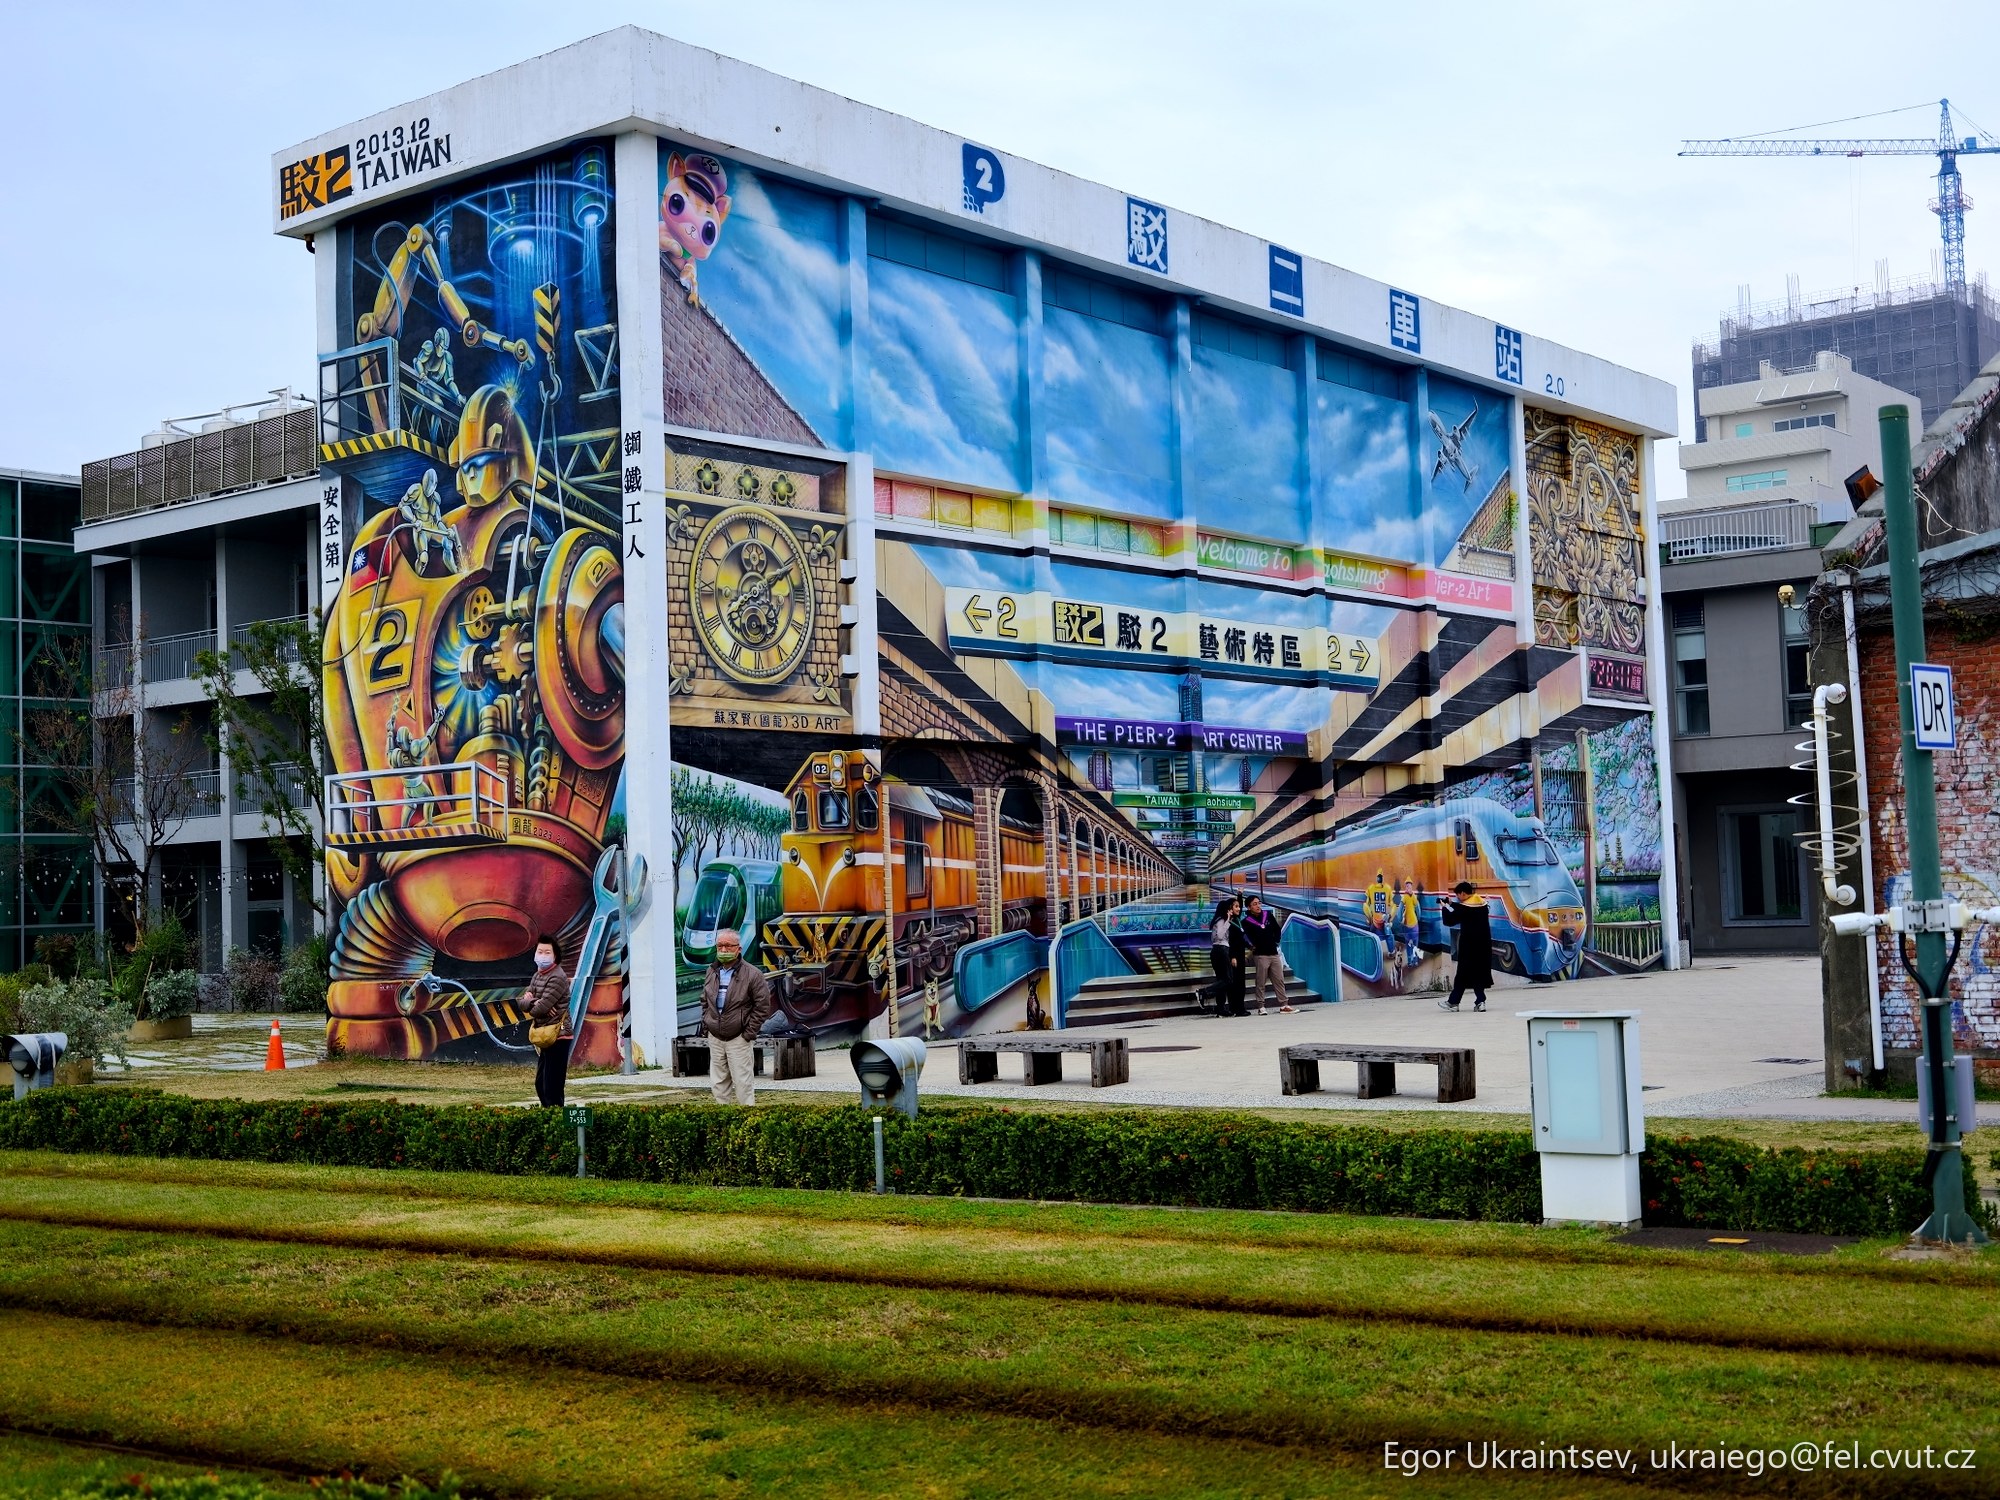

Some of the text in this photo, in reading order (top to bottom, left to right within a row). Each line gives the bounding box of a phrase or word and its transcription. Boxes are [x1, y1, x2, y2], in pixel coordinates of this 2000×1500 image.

[356, 117, 430, 161] 2013.12
[358, 133, 452, 190] TAIWAN
[1546, 373, 1564, 396] 2.0
[623, 430, 646, 559] 鋼鐵工人
[323, 486, 341, 584] 安全第一
[1273, 548, 1290, 571] to
[1466, 582, 1491, 602] Art
[371, 609, 407, 683] 2
[998, 597, 1018, 638] 2
[1200, 623, 1302, 668] 藝術特區
[1327, 635, 1342, 671] 2
[815, 716, 841, 731] ART
[1920, 681, 1947, 732] DR
[1075, 722, 1107, 742] THE
[1115, 725, 1177, 745] PIER-2
[1230, 733, 1283, 750] CENTER
[815, 765, 827, 773] 02
[1145, 795, 1180, 806] TAIWAN
